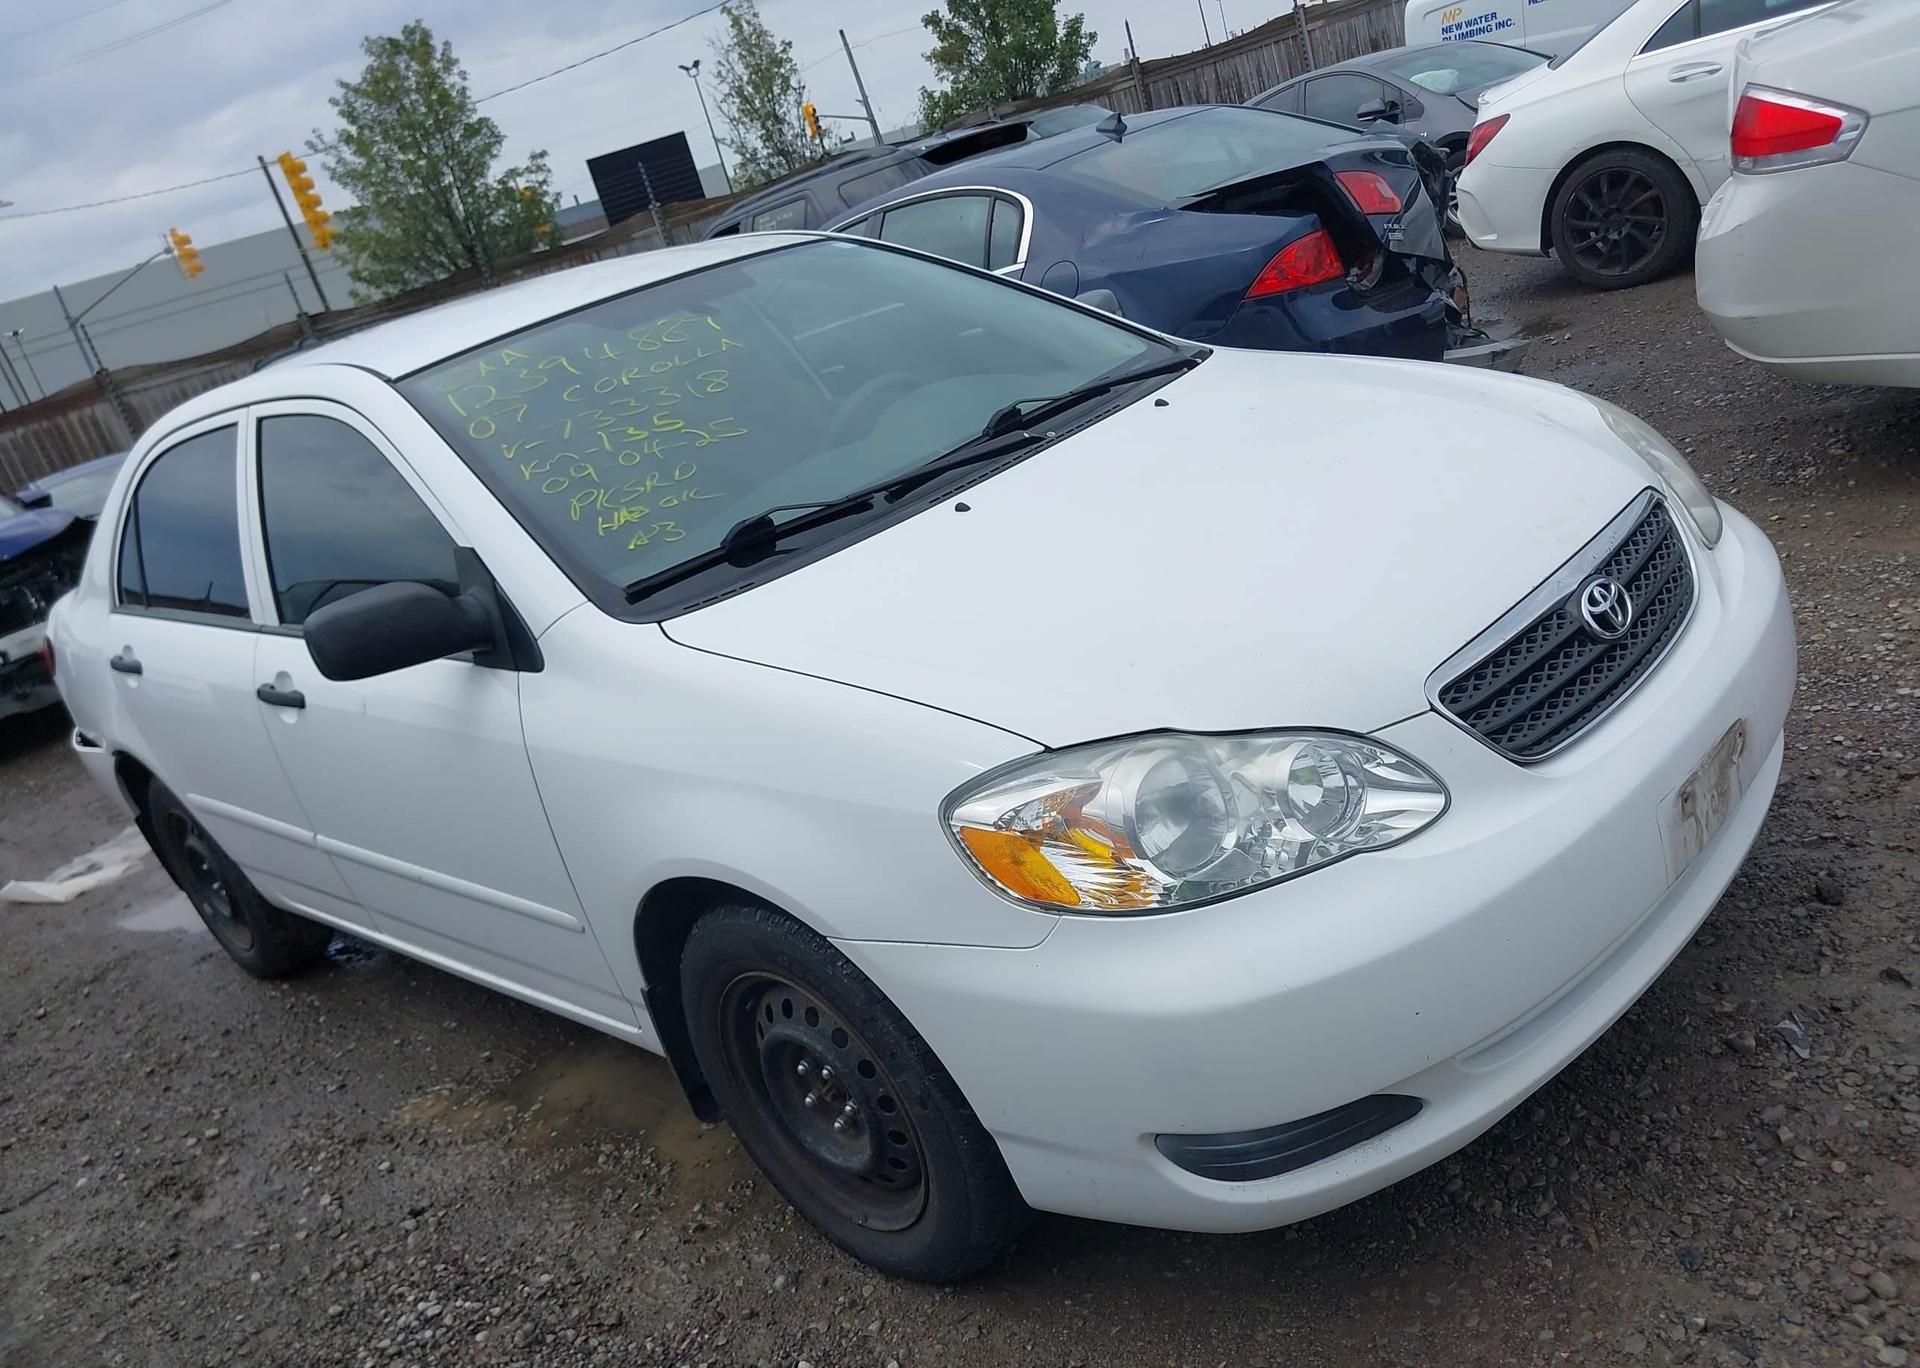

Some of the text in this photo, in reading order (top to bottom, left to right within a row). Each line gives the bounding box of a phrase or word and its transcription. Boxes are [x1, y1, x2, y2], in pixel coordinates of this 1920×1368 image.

[1442, 12, 1498, 35] NEW WATER
[1495, 18, 1516, 31] INC.
[469, 339, 744, 439] 07 COROLLA
